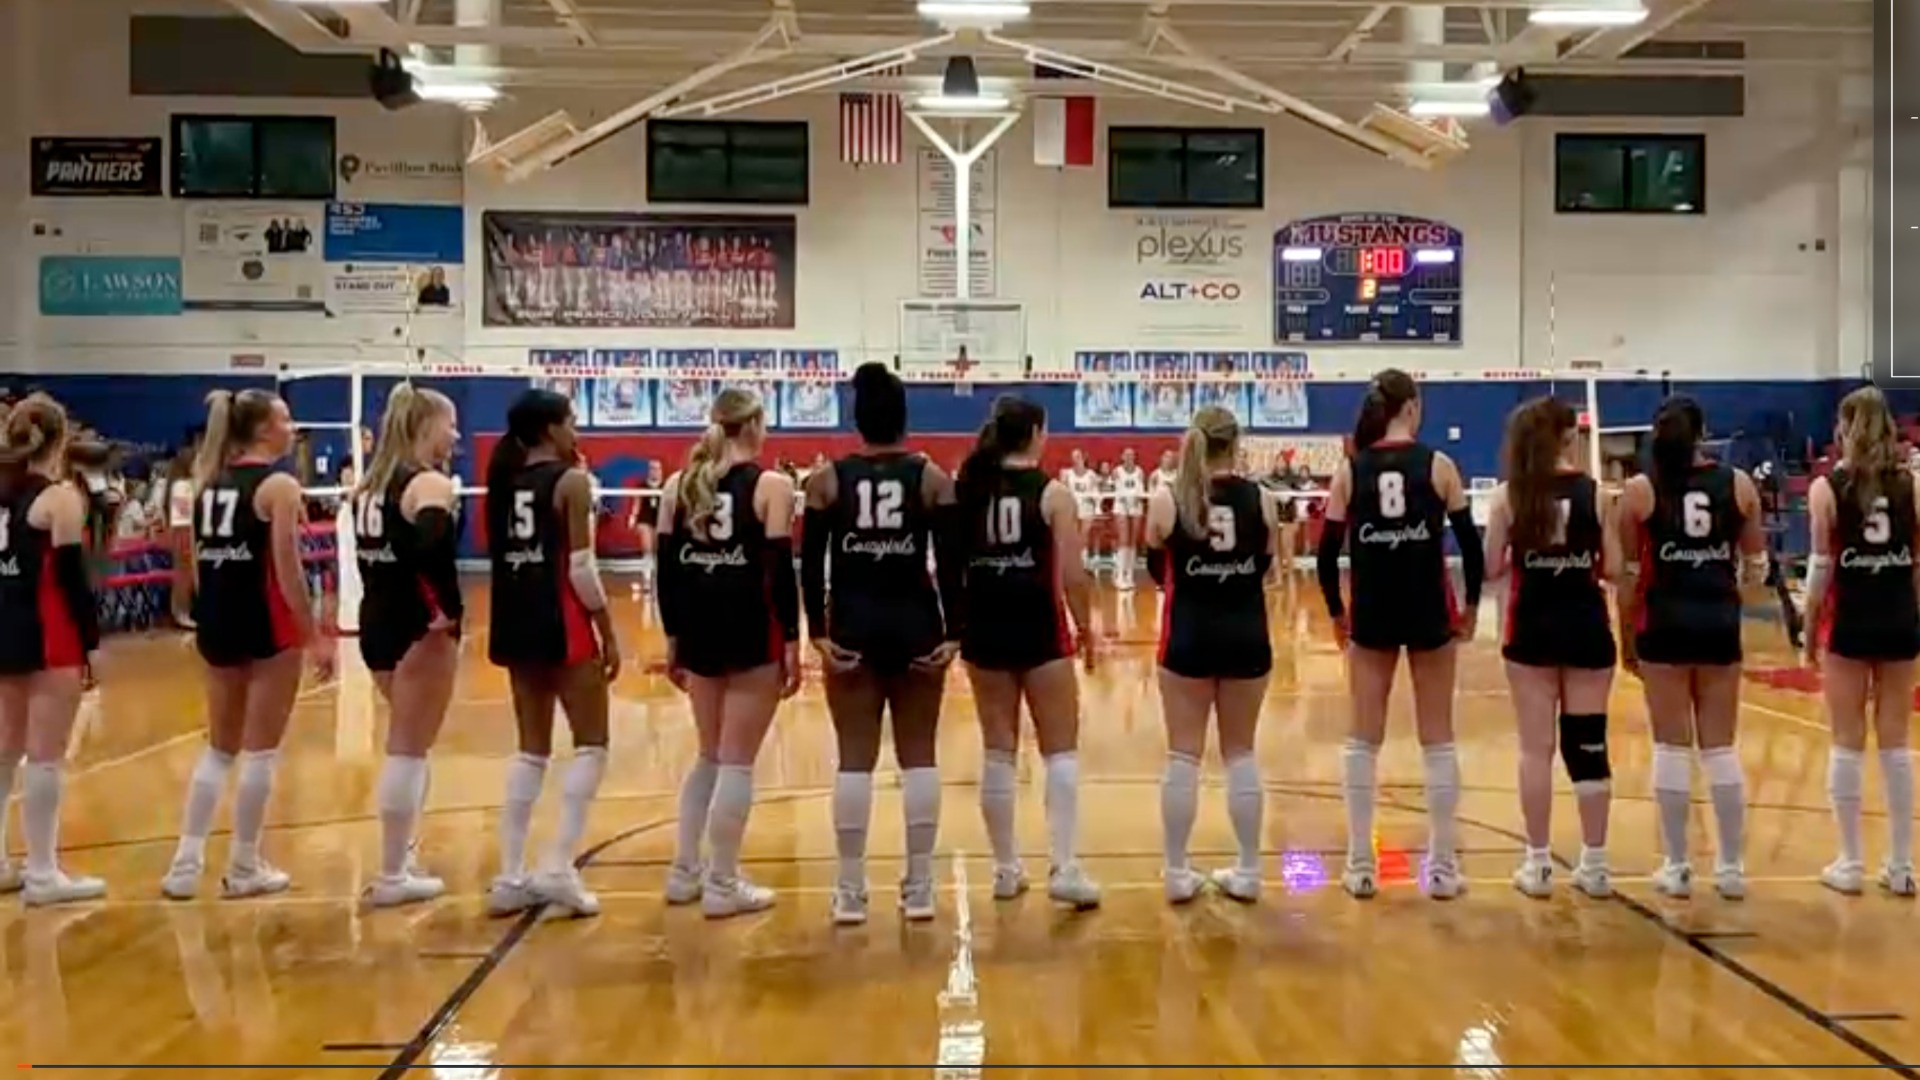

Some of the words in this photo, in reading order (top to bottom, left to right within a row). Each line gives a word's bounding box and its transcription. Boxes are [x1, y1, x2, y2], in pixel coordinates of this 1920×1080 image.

[47, 156, 144, 182] PANTHERS
[1137, 227, 1243, 263] plexus
[1292, 223, 1448, 246] MUSTANGS
[1140, 282, 1241, 300] ALT+CO
[1363, 279, 1376, 298] 2
[856, 479, 905, 530] 12
[1377, 471, 1407, 519] 8
[202, 488, 240, 537] 17
[507, 490, 536, 539] 5
[985, 495, 1023, 545] 10
[1207, 505, 1237, 551] 9
[1683, 490, 1713, 538] 6
[1862, 496, 1891, 544] 5
[842, 531, 916, 562] Cowgirls
[1358, 520, 1431, 549] Cowgirls
[678, 541, 749, 575] Cowgirls
[1185, 554, 1257, 584] Cowgirls
[1524, 549, 1593, 578] Cowgirls
[1659, 541, 1731, 570] Cowgirls
[1840, 544, 1912, 575] Cowgirls
